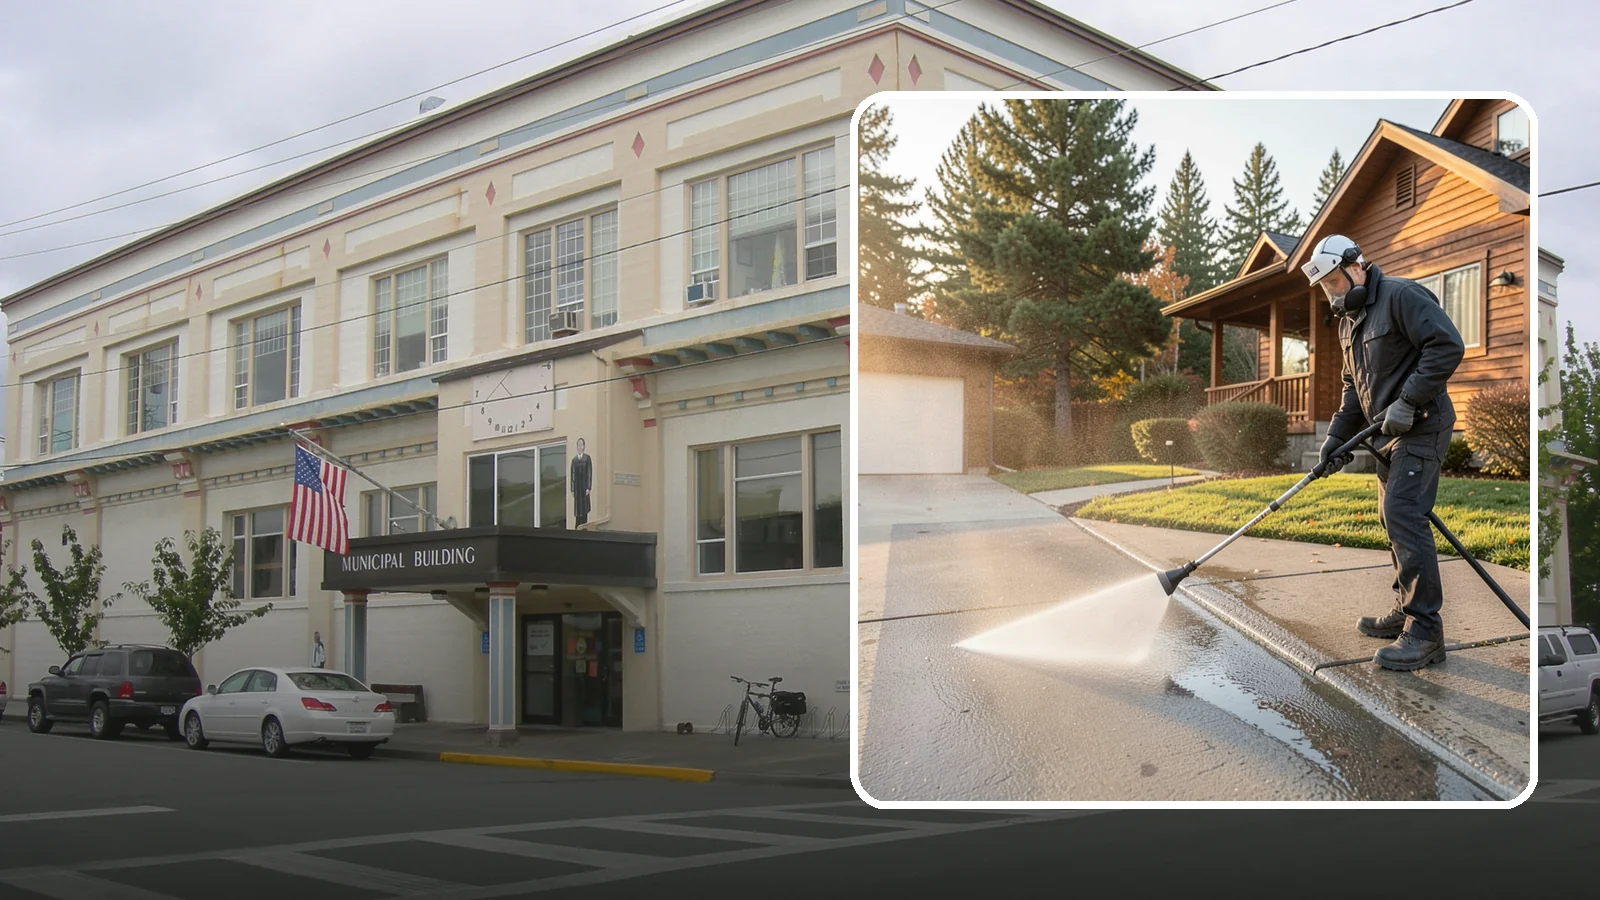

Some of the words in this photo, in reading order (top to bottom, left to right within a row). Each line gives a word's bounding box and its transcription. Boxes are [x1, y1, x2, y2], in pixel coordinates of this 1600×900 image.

[547, 362, 551, 370] 6
[536, 402, 540, 410] 4
[480, 407, 485, 415] 8
[487, 417, 492, 426] 9
[529, 414, 533, 422] 3
[495, 424, 500, 432] 10
[521, 420, 526, 428] 2
[501, 426, 506, 434] 11
[507, 425, 513, 433] 12
[342, 552, 405, 572] MUNICIPAL
[414, 546, 475, 567] BUILDING
